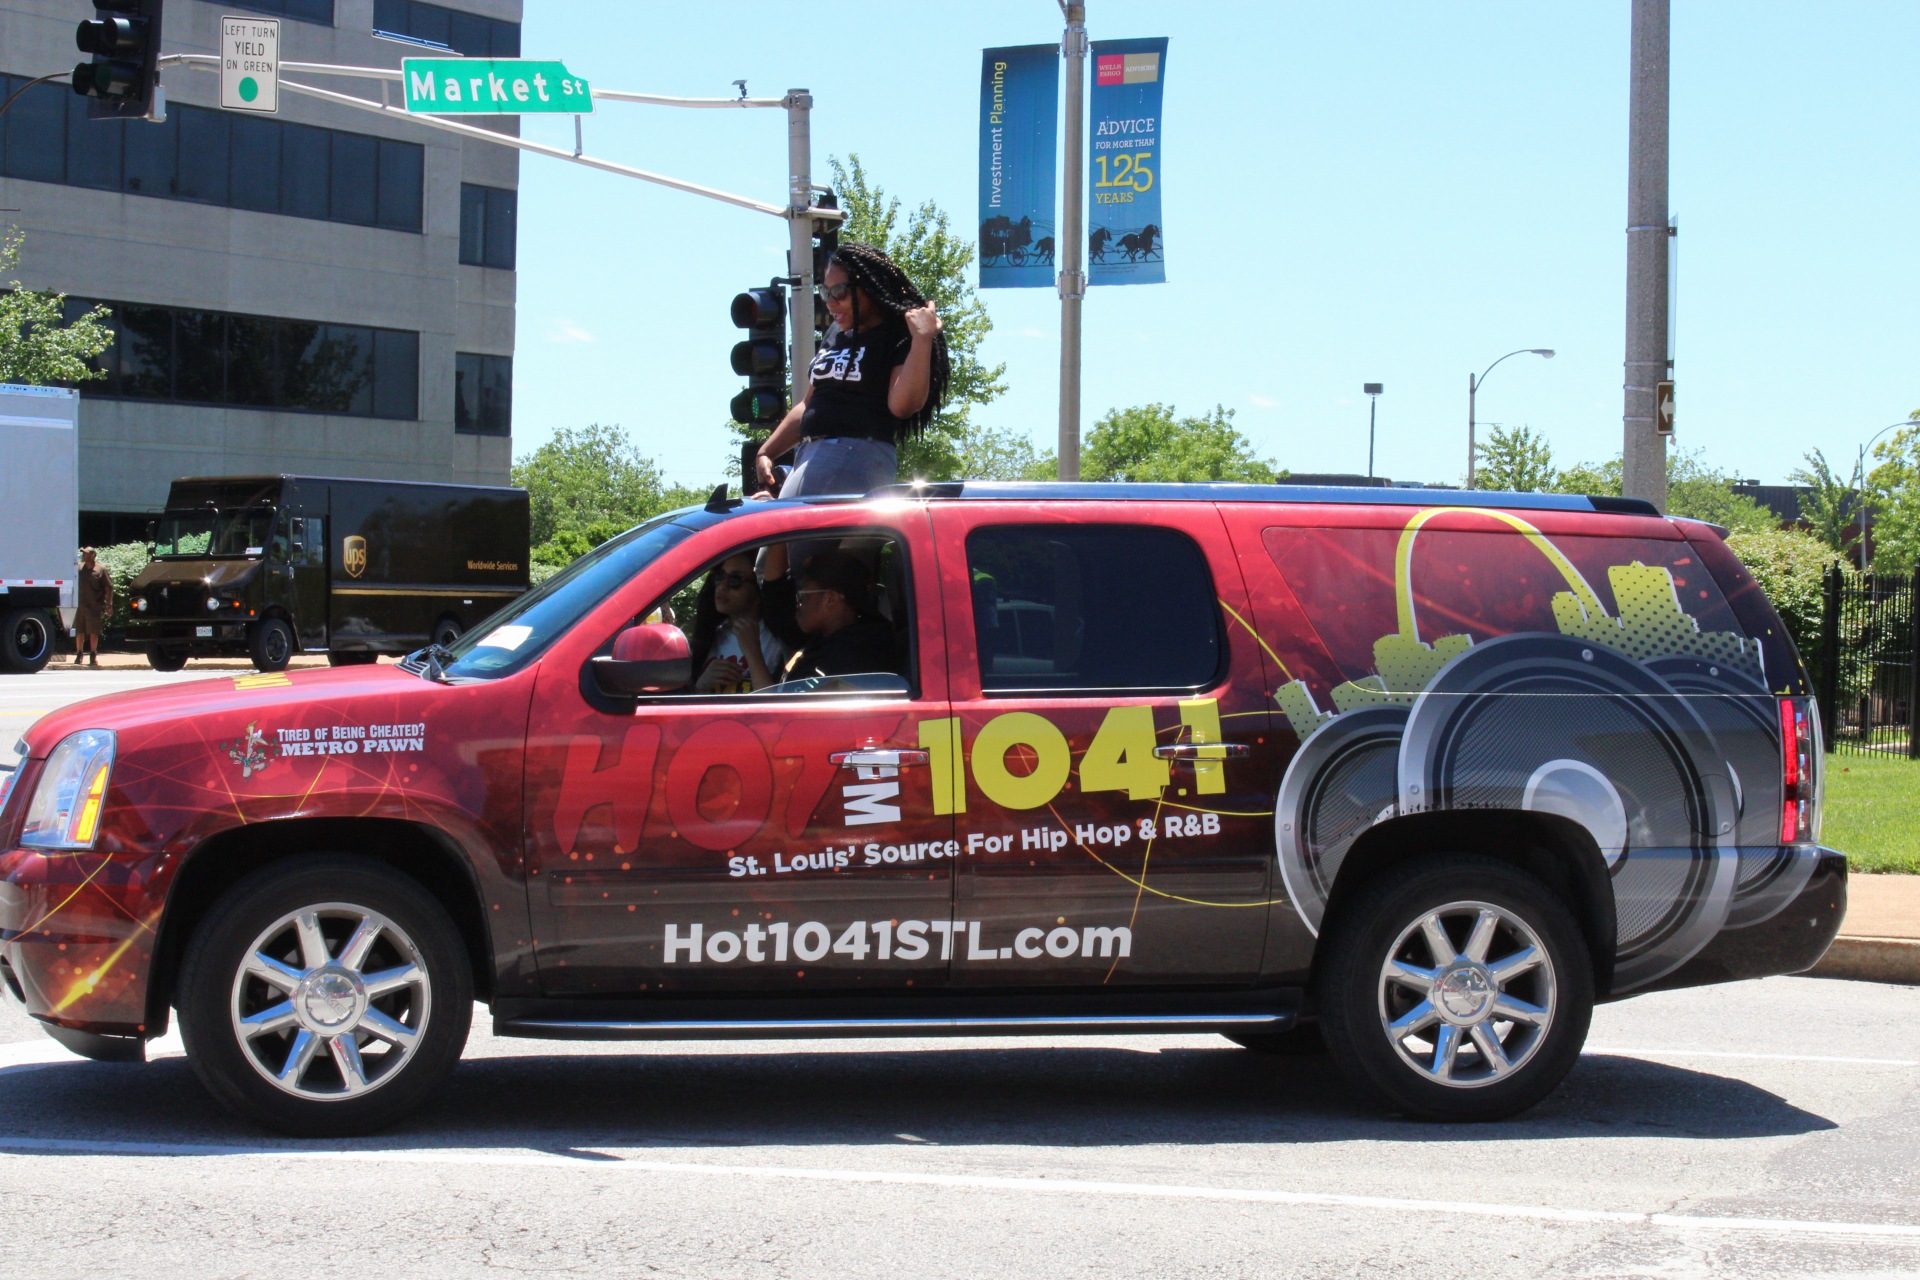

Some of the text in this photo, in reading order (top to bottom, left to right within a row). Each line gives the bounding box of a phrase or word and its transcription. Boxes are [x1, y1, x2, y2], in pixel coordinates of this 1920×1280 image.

[225, 25, 275, 38] LEFT TURN
[235, 41, 265, 56] YIELD
[226, 59, 273, 72] ON GREEN
[410, 71, 583, 102] Market St
[989, 61, 1006, 207] Investment Planning
[1096, 118, 1155, 136] ADVICE
[1095, 138, 1155, 150] FOR MORE THAN
[1095, 152, 1153, 192] 125
[1095, 191, 1134, 204] YEARS
[345, 548, 365, 571] ups
[467, 560, 518, 571] Worldwide Services
[277, 722, 426, 742] TIRED OF BEING CHEATED?
[281, 737, 424, 757] METRO PAWN
[917, 698, 1226, 815] 104.1
[553, 715, 906, 855] HOT
[842, 752, 901, 826] FM
[728, 813, 1221, 877] St. Louis' Source For Hip Hop & R&B
[662, 920, 1132, 963] Hot1041STL.com
